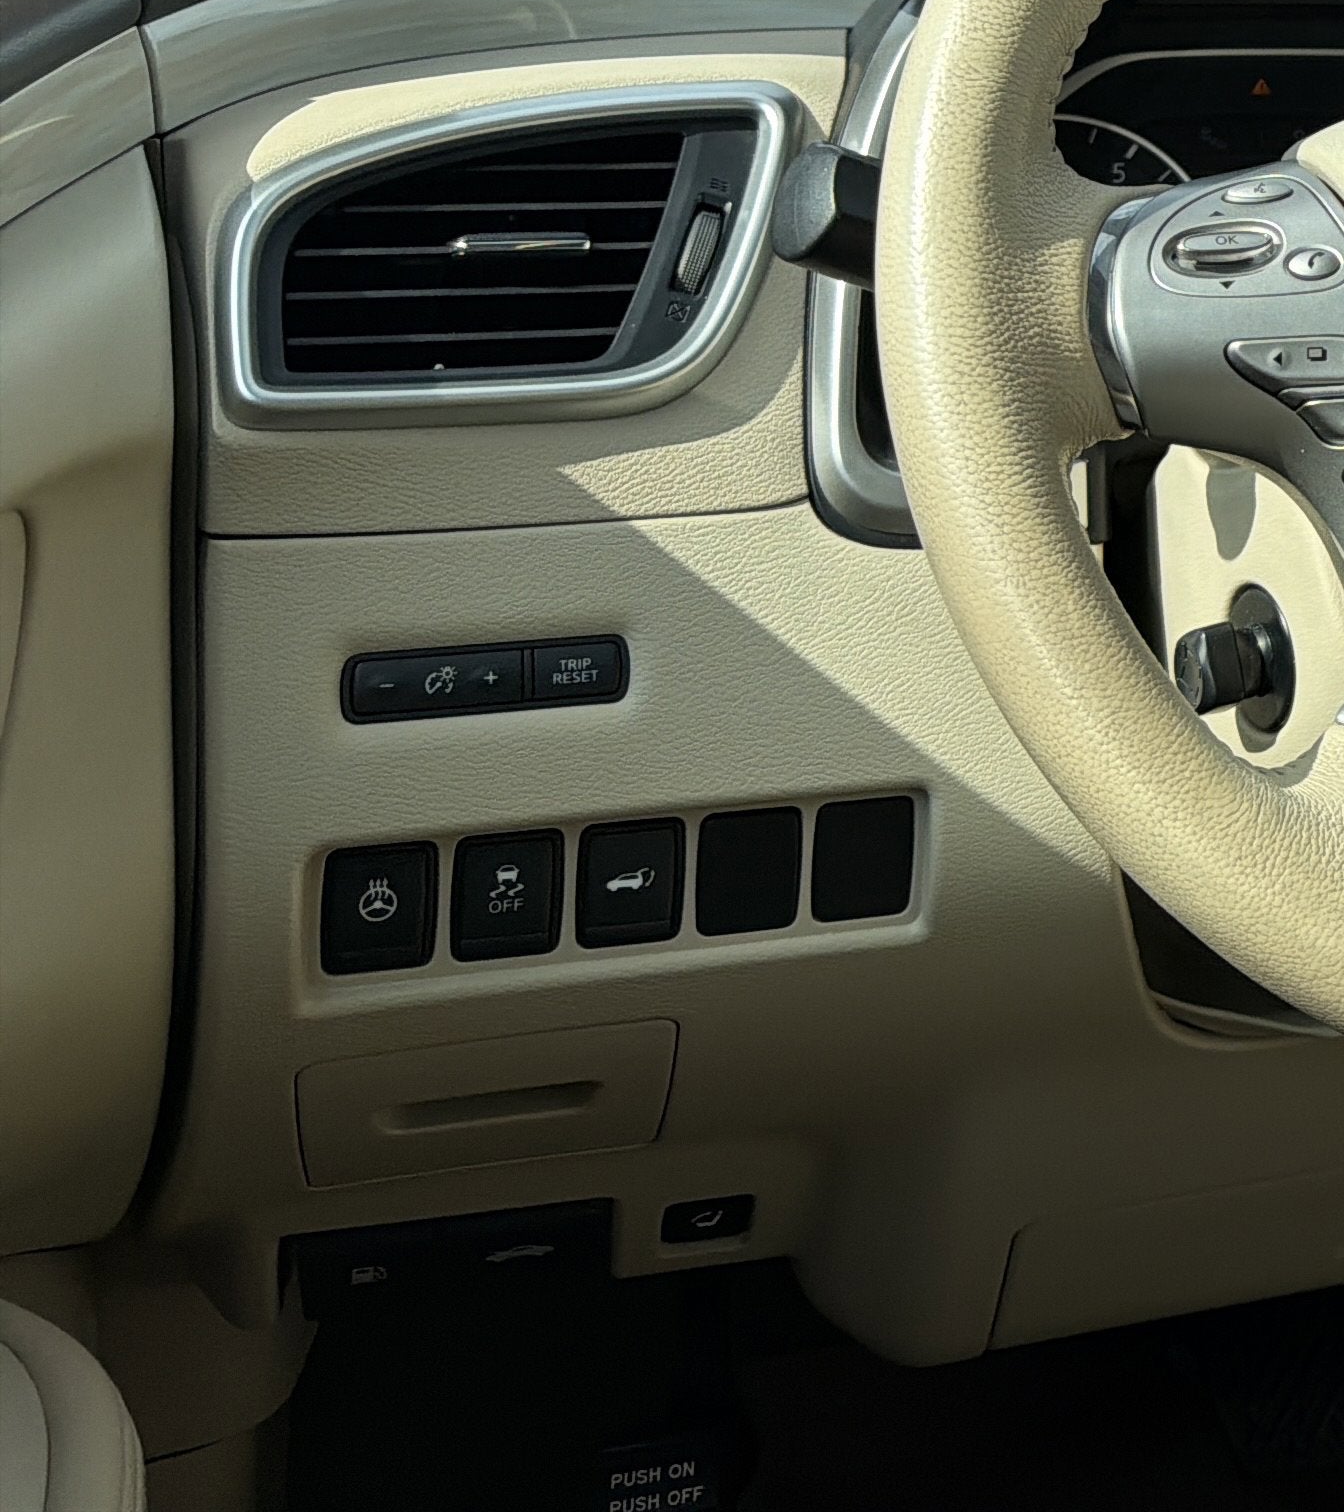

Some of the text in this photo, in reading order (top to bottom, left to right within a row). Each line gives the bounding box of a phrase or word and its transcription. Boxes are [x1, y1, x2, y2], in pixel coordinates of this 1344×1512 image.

[1111, 162, 1126, 183] 5
[1215, 233, 1239, 247] OK
[559, 657, 593, 672] TRIP
[552, 669, 600, 685] RESET
[488, 897, 525, 915] OFF
[610, 1460, 696, 1490] PUSH ON
[609, 1484, 705, 1512] PUSH OFF
